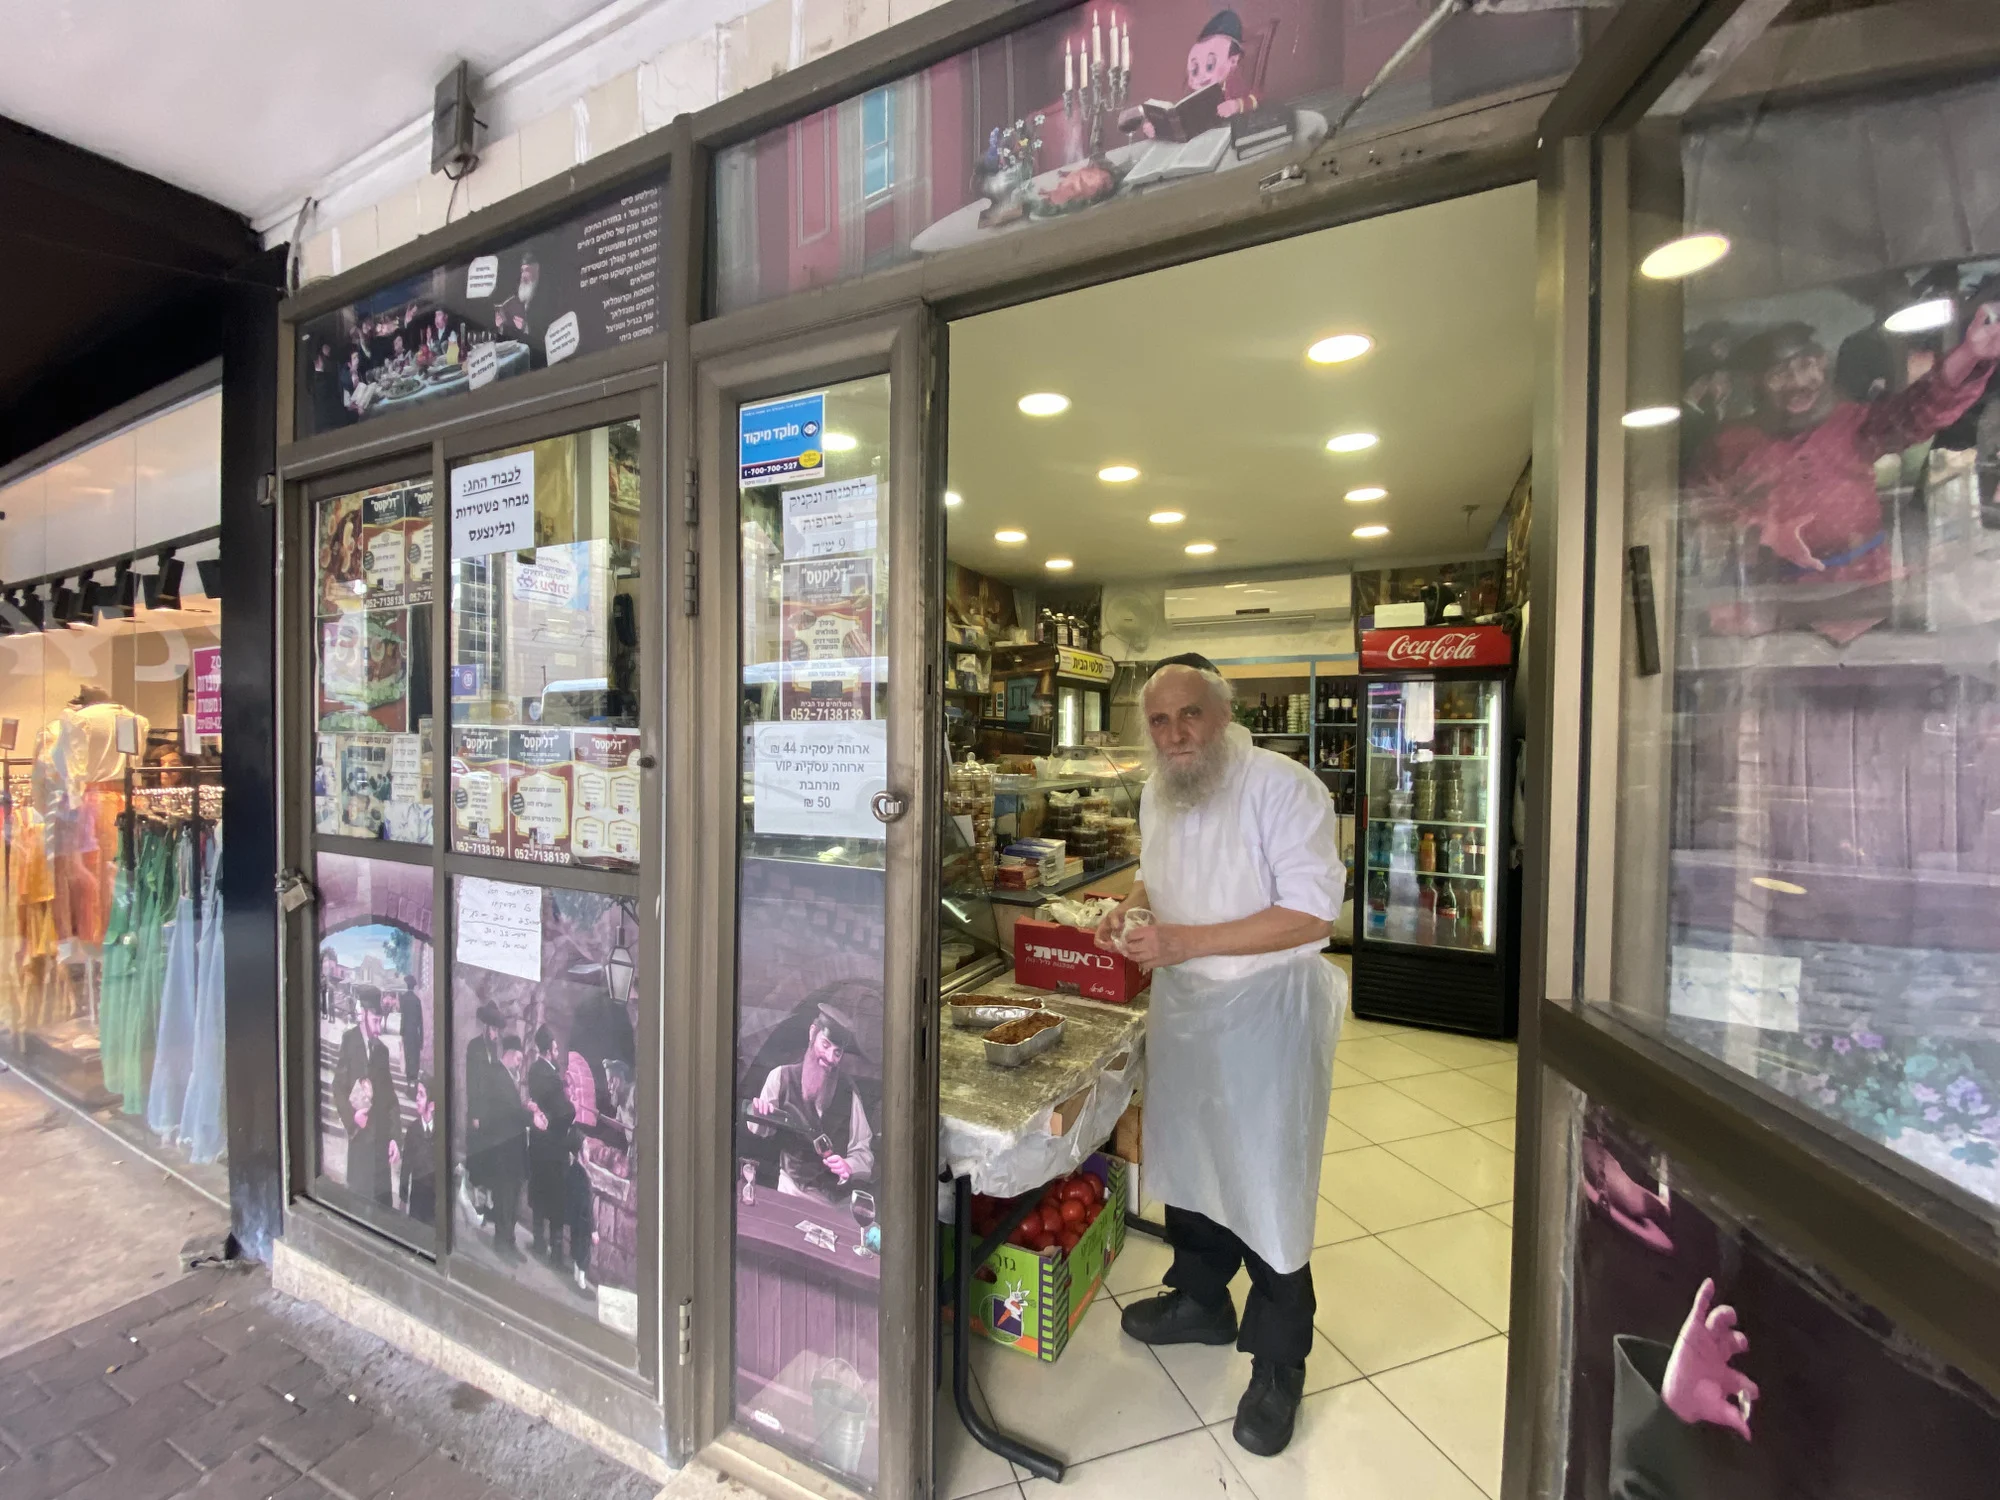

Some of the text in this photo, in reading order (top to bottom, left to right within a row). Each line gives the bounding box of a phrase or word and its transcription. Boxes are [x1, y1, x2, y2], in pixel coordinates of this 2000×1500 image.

[577, 216, 658, 250] מבחר ענק של סלטים ביתיים
[628, 235, 642, 246] דגים
[640, 243, 657, 254] מבחר
[580, 280, 588, 288] יום
[589, 276, 598, 284] יום
[630, 270, 655, 286] ממולאים
[635, 298, 654, 310] מרקים
[606, 312, 654, 334] עוף בגריל ושניצל
[744, 422, 799, 445] מוקד מיקוד
[744, 461, 798, 477] 1-700-700-327
[463, 466, 521, 492] לכבוד החג:
[456, 493, 530, 520] מבחר פשטידות
[789, 492, 822, 513] ונקניק
[468, 521, 515, 542] ובלינצעס
[838, 537, 846, 550] 9
[1387, 632, 1482, 660] Coca-Cola
[1072, 658, 1088, 670] הבית
[1089, 660, 1104, 674] סלטי
[790, 708, 863, 721] 052-7138139
[770, 742, 870, 756] ארוחה עסקית 44 ₪
[776, 760, 864, 775] ארוחה עסקית VIP
[799, 780, 840, 791] מורחבת
[804, 796, 831, 808] 50 ₪
[456, 841, 506, 857] 052-7138139
[514, 848, 570, 864] 052-7138139
[1033, 945, 1114, 970] בראשית
